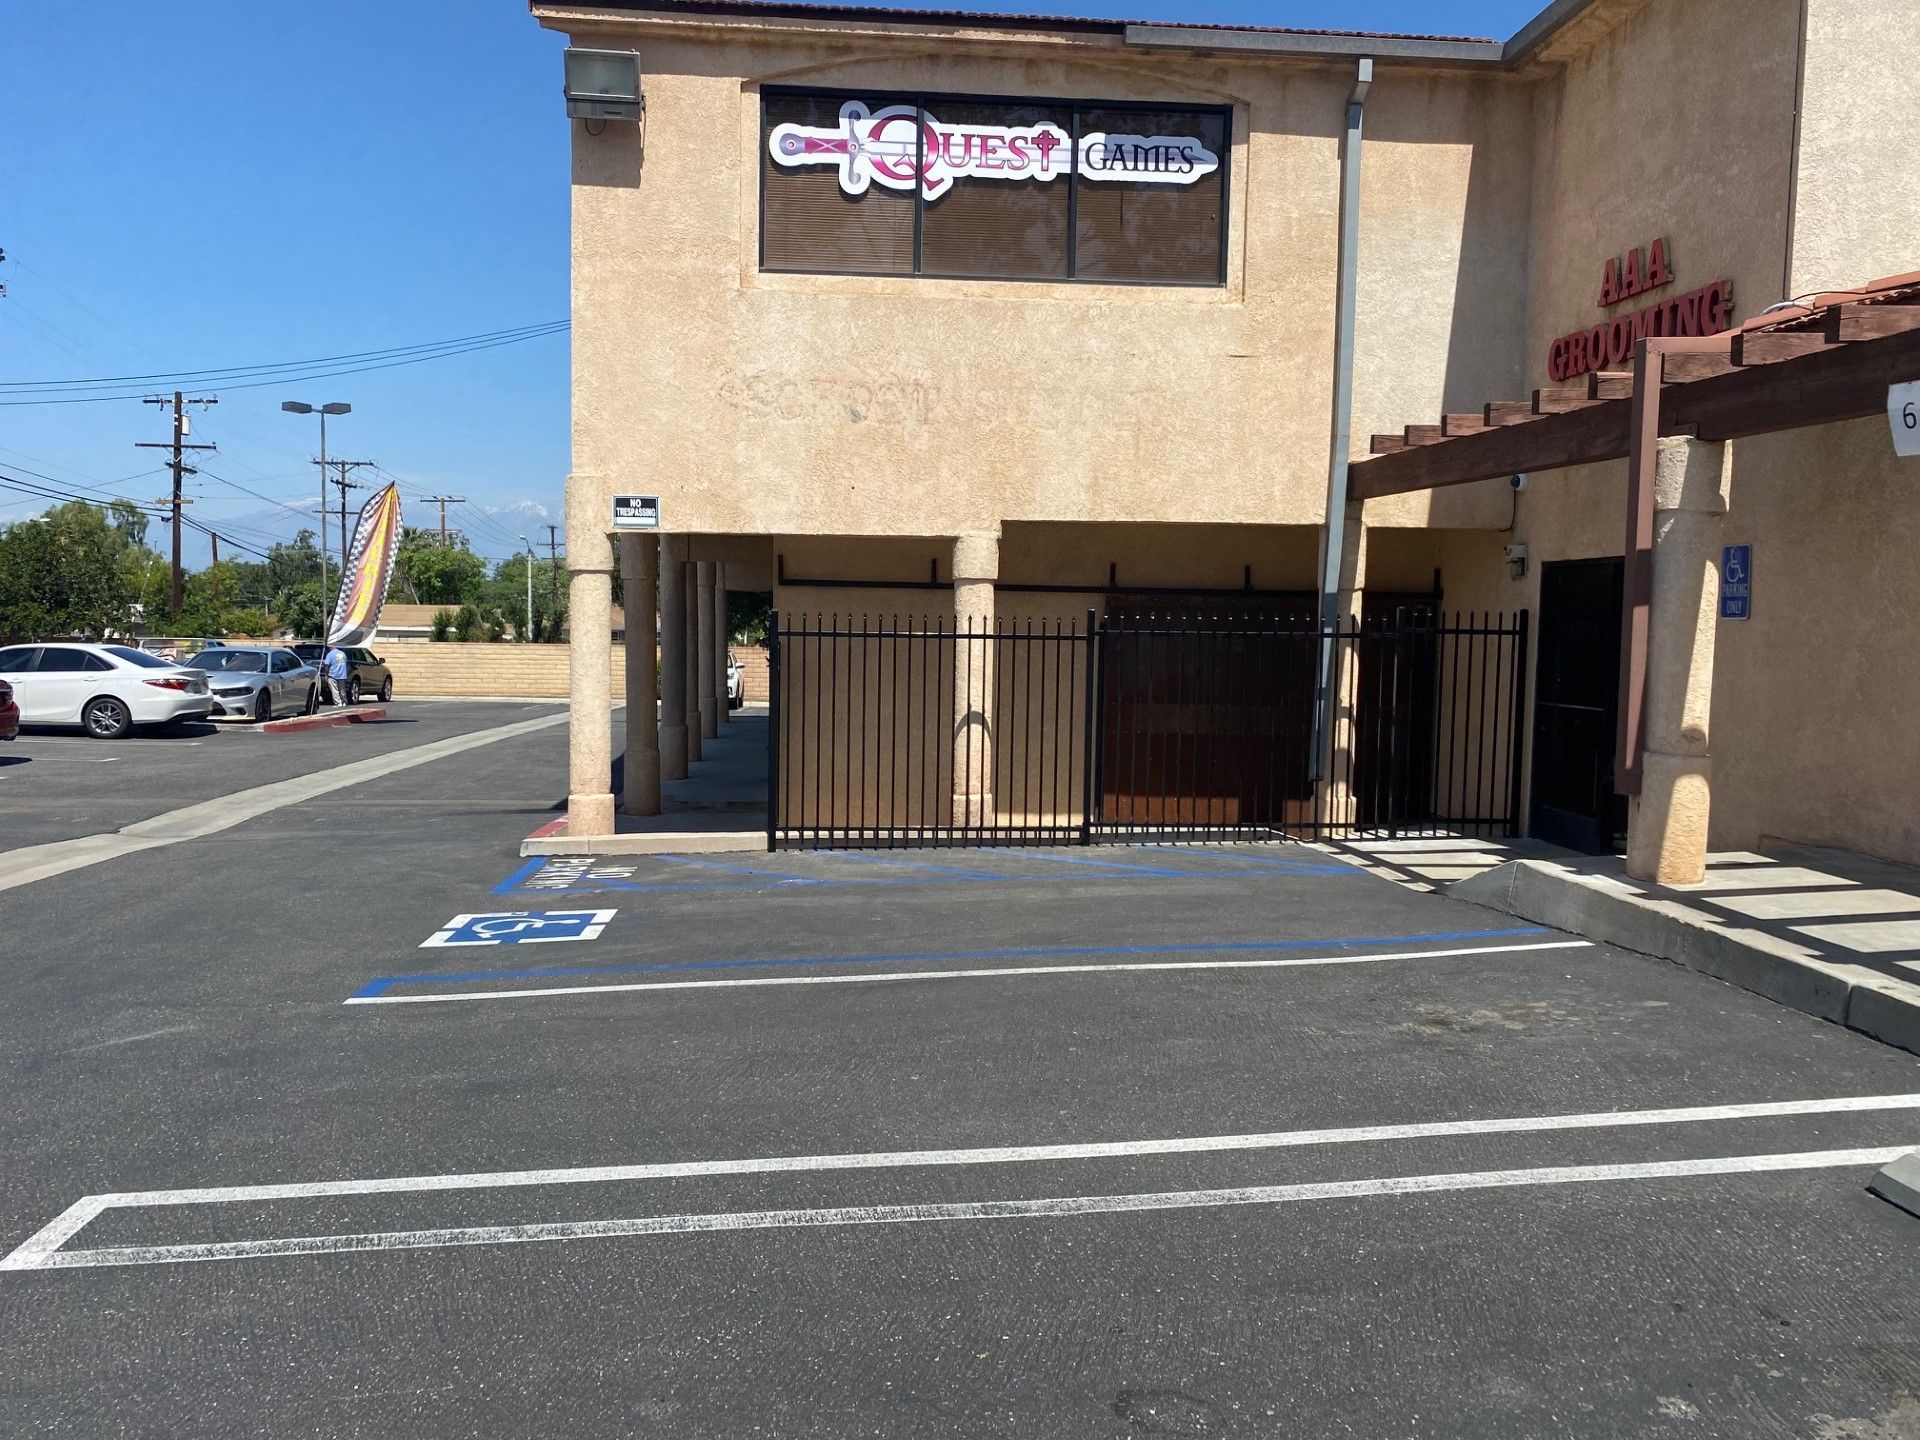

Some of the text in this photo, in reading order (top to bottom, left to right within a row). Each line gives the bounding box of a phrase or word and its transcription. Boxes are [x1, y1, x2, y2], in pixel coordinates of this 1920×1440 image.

[867, 113, 1194, 191] QUEST GAMES
[1597, 237, 1674, 307] AAA
[1548, 280, 1735, 382] GROOMING
[629, 498, 642, 508] NO
[616, 507, 656, 517] TRESPASSING
[1722, 583, 1747, 597] PARKING
[1726, 600, 1743, 614] ONLY
